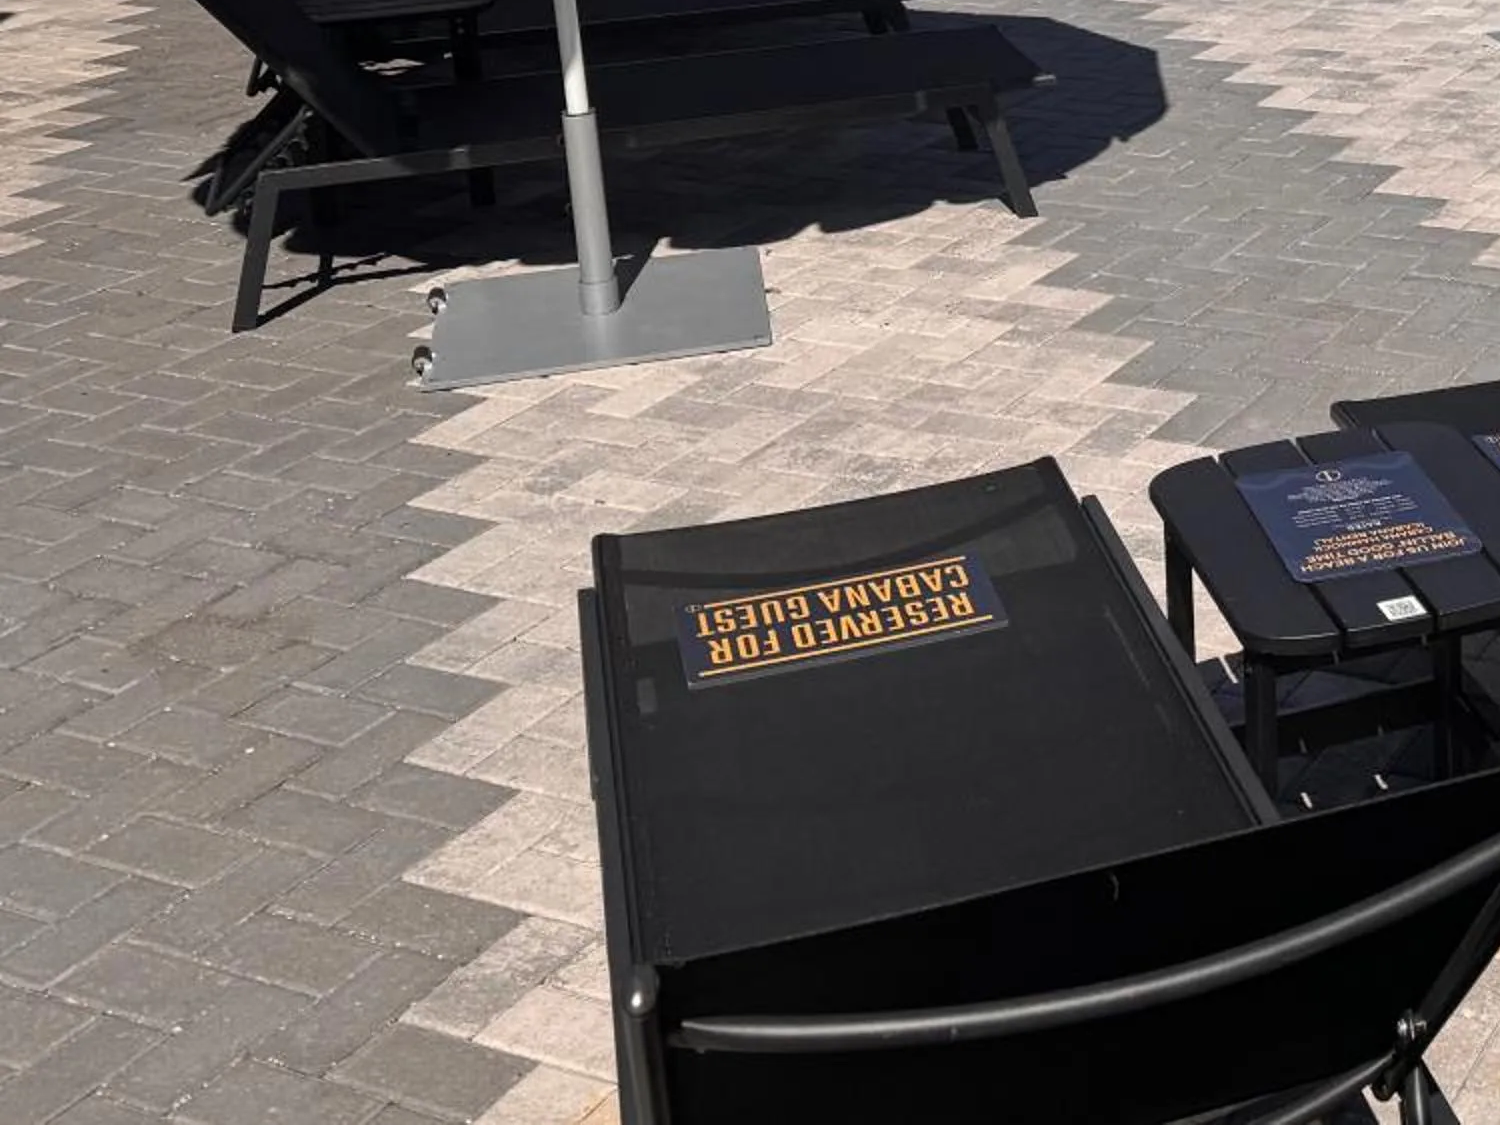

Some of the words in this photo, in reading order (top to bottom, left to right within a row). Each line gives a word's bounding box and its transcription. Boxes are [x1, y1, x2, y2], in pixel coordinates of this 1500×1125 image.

[1348, 543, 1395, 556] GOOD
[817, 563, 970, 612] CABANA
[696, 595, 811, 637] GUEST
[791, 591, 975, 648] RESERVED
[708, 629, 780, 664] FOR
